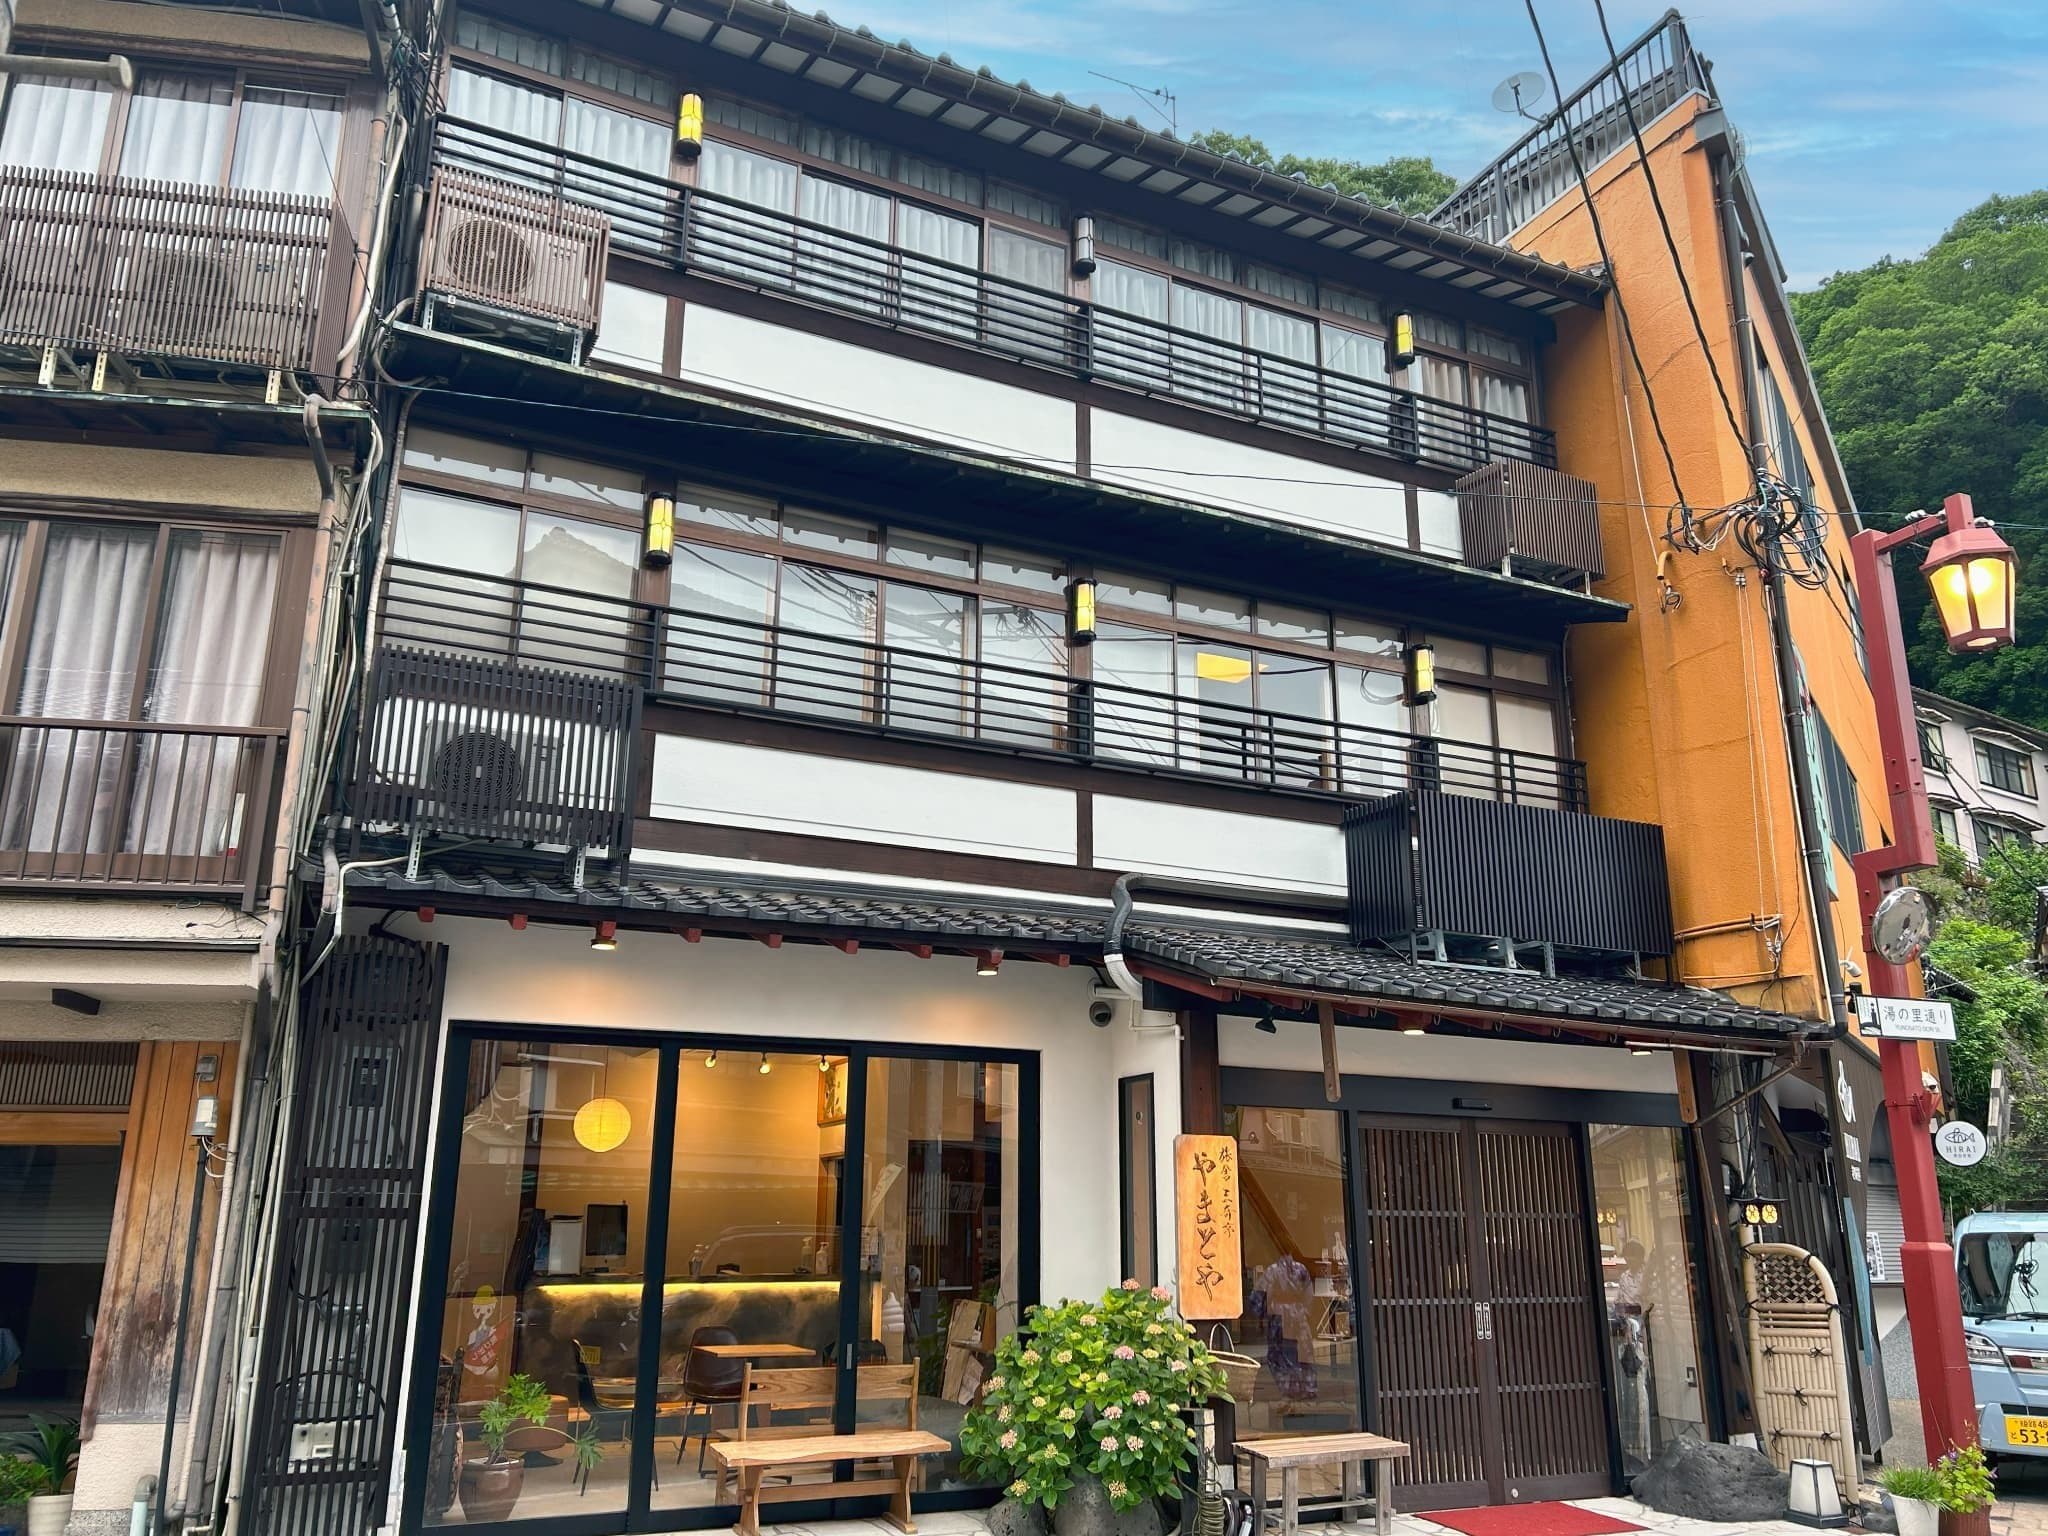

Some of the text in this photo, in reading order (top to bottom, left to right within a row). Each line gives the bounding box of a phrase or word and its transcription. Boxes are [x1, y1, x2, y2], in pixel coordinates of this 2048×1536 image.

[1883, 1005, 1947, 1024] 湯の里通り
[1945, 1145, 1976, 1153] HIRAI
[1192, 1151, 1224, 1302] やまとや
[2019, 1429, 2048, 1443] 53-
